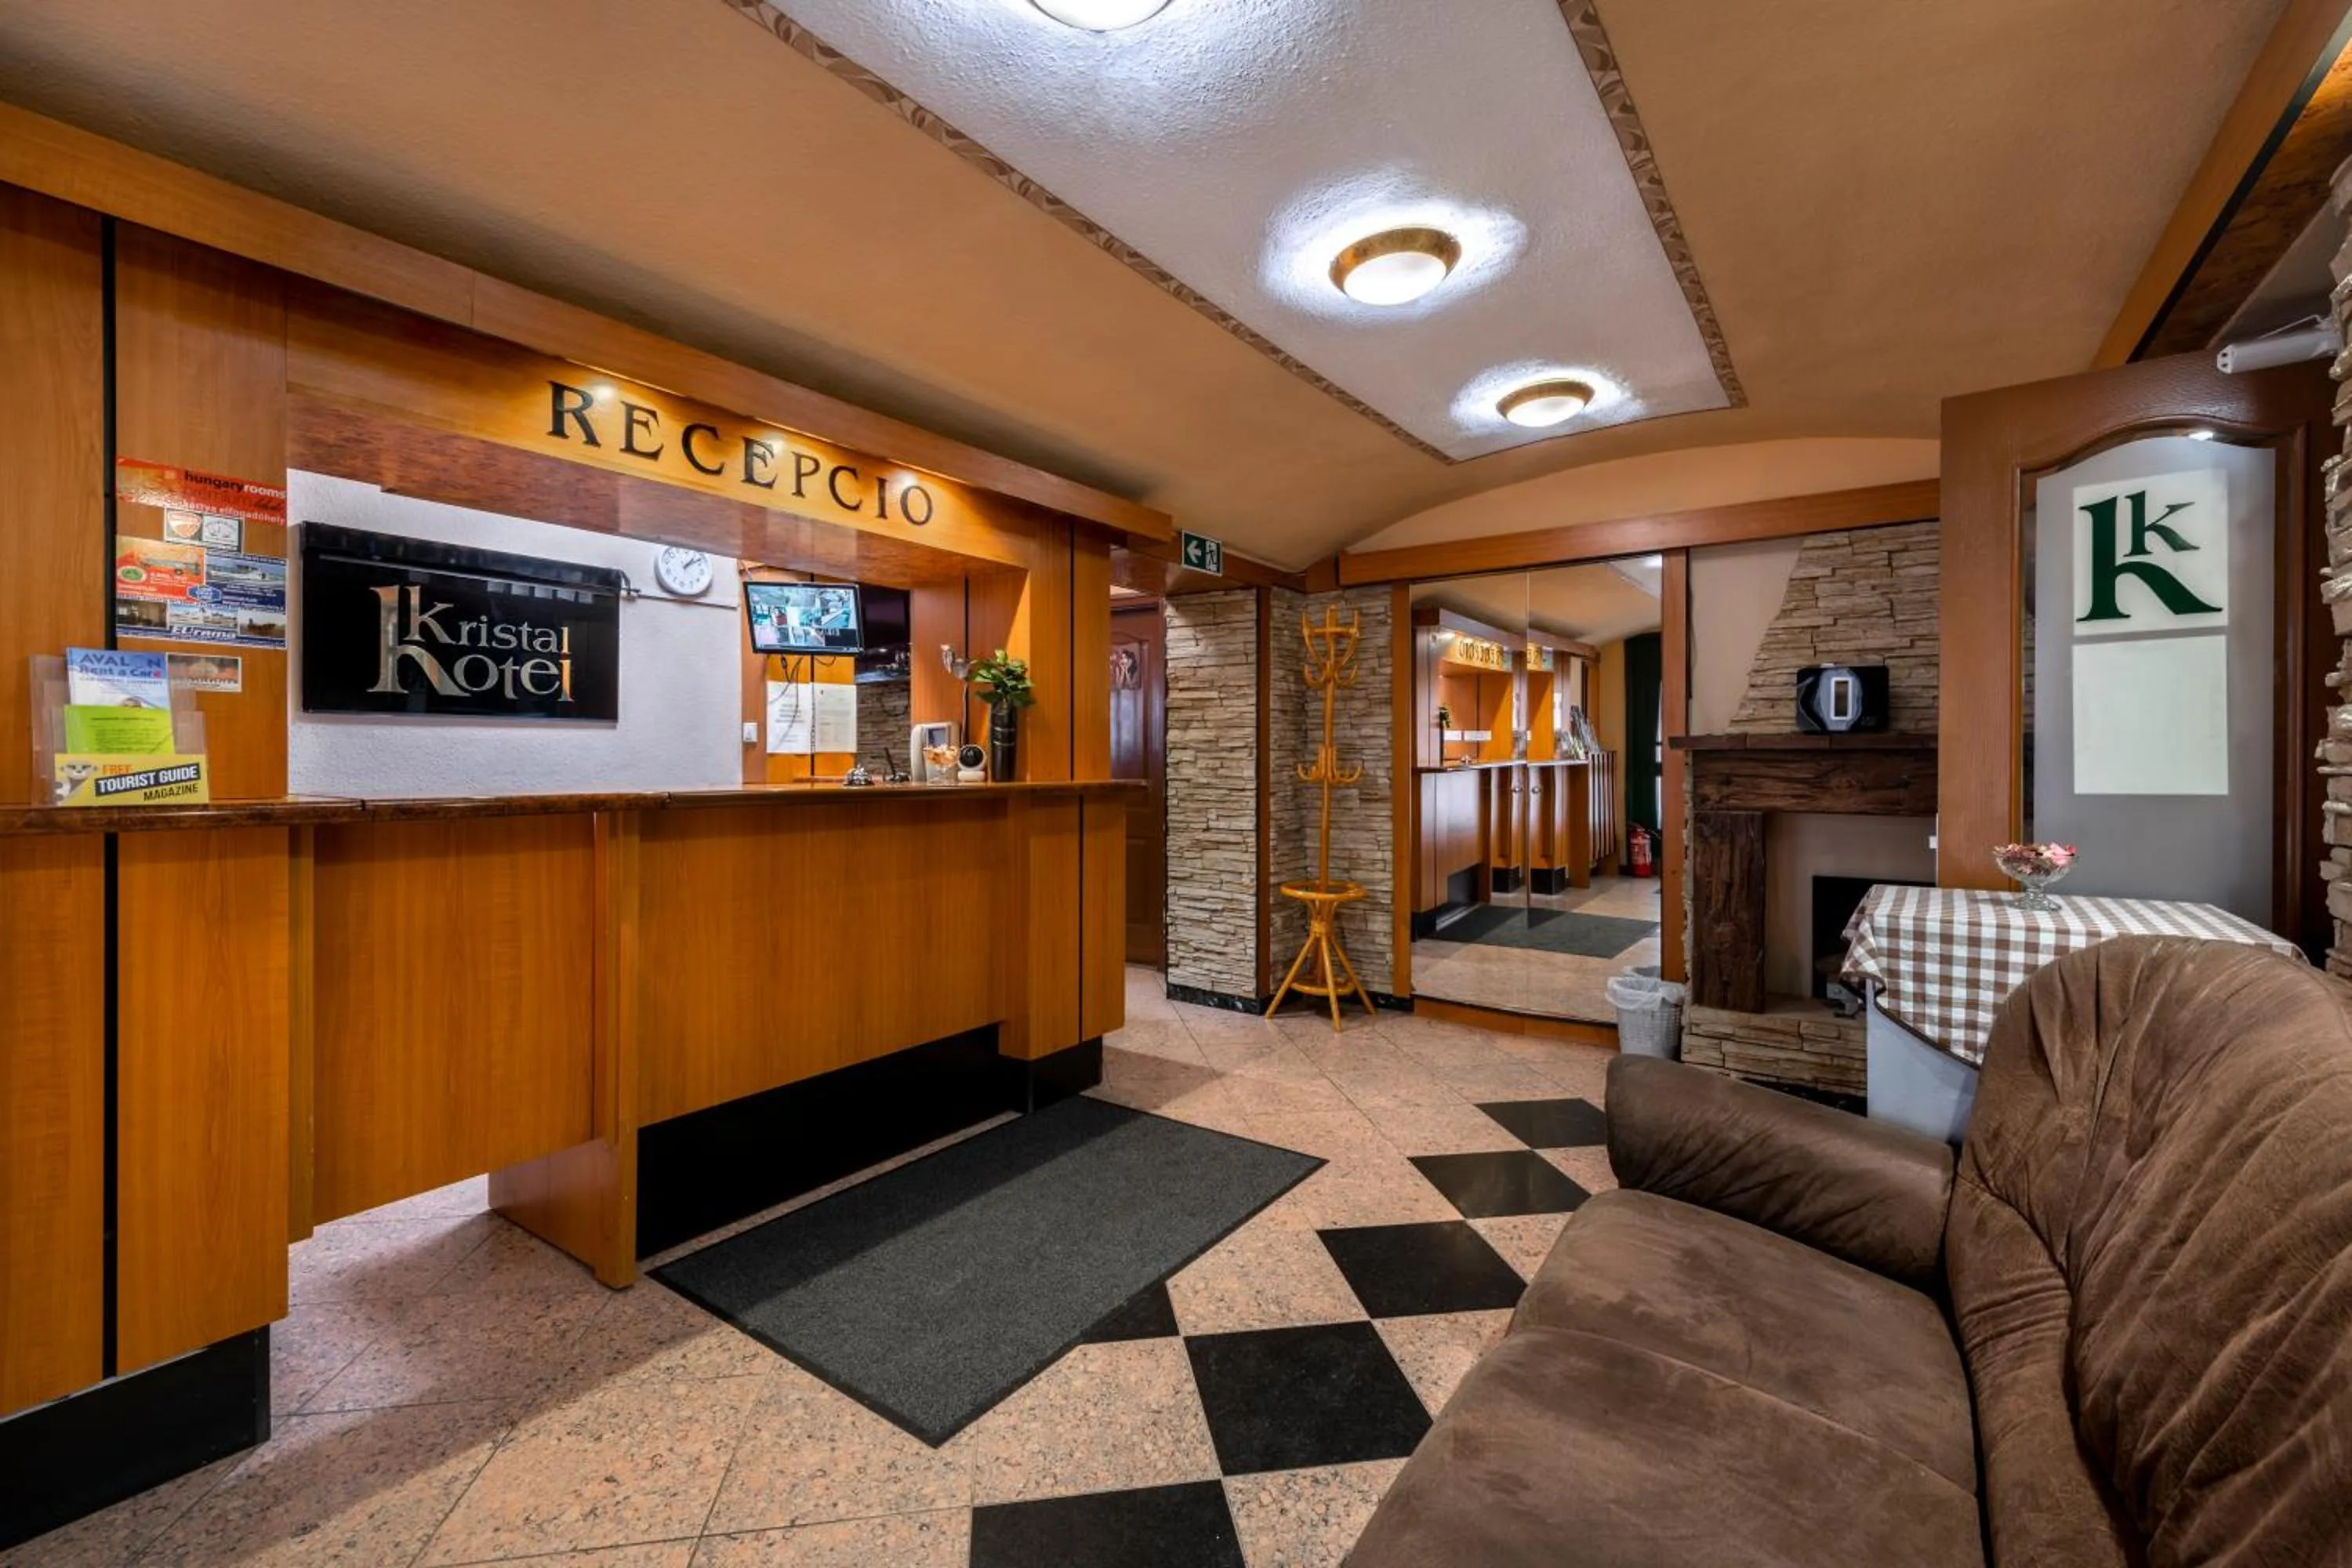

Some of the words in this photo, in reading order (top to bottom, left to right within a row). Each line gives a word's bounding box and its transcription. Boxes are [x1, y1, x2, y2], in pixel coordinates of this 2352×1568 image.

[546, 381, 934, 526] RECEPCIO
[79, 653, 162, 668] AVALN
[98, 772, 156, 793] TOURIST
[158, 765, 198, 783] GUIDE
[103, 764, 132, 775] FREE
[143, 782, 198, 801] MAGAZINE
